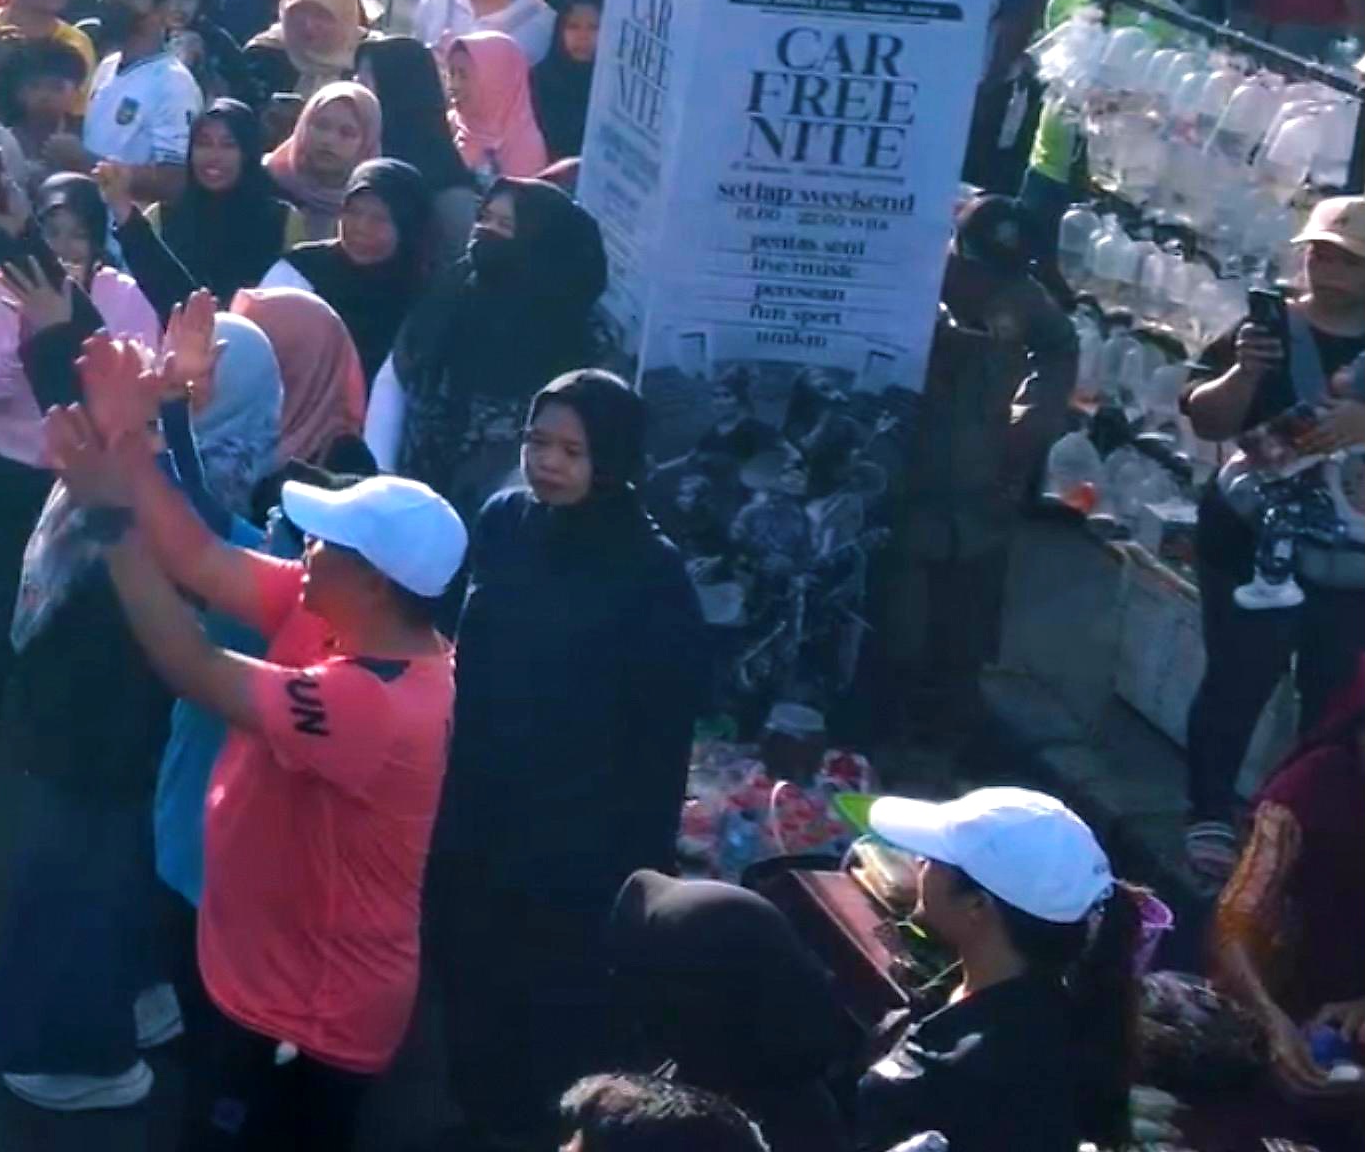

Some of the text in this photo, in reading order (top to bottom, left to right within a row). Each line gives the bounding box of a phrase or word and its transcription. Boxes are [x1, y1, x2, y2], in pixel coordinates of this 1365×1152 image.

[776, 26, 905, 77] CAR
[746, 71, 918, 124] FREE
[743, 116, 908, 170] NITE
[718, 181, 916, 212] setiap weekend
